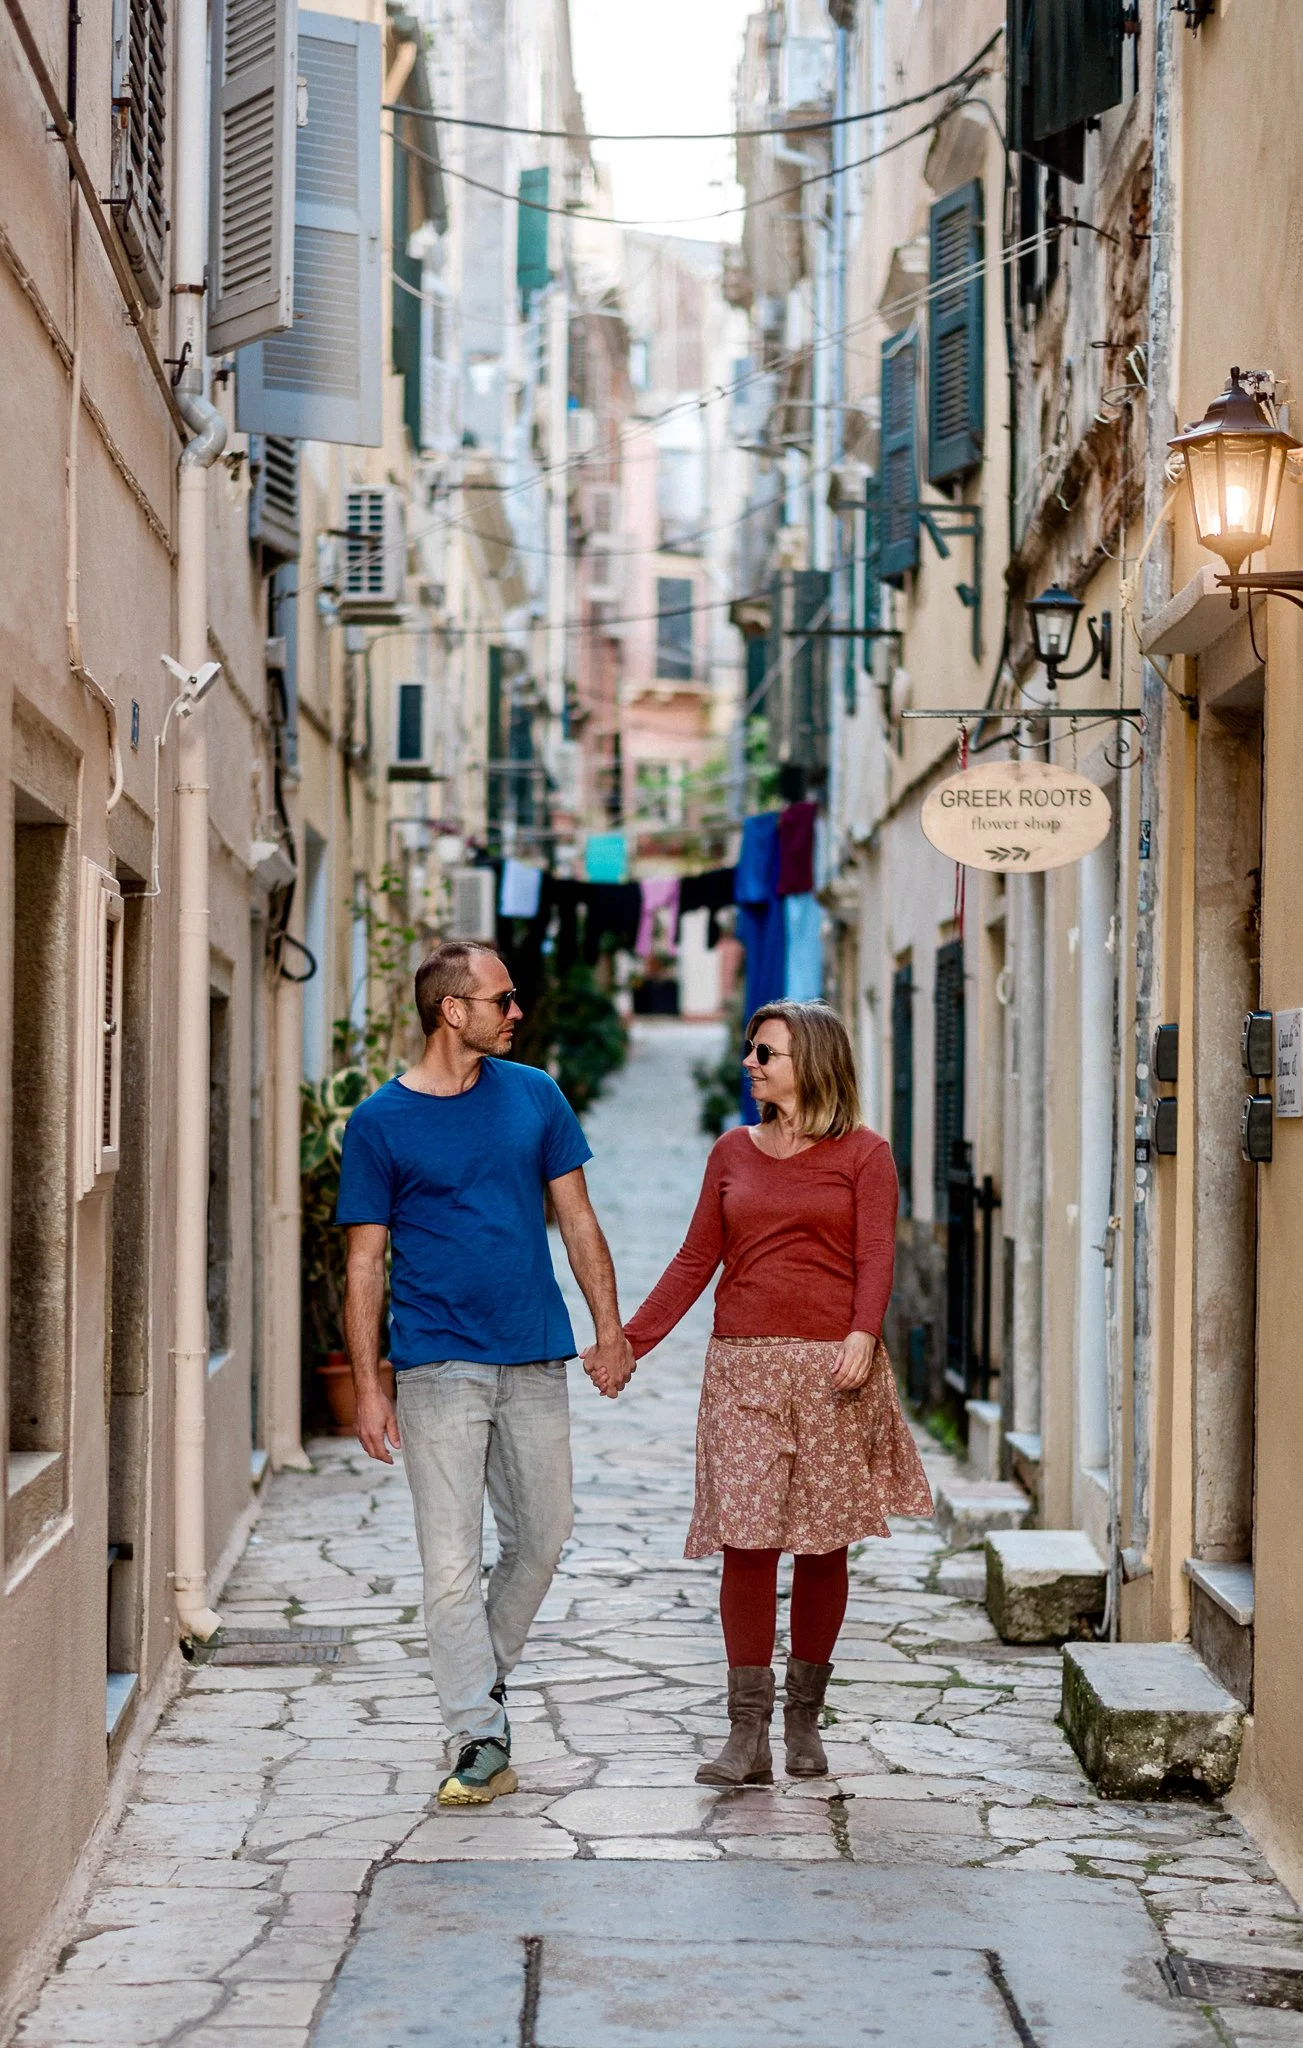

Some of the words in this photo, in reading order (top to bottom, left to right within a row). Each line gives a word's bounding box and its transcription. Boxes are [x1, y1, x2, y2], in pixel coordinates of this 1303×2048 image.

[940, 789, 1013, 808] GREEK
[1019, 788, 1092, 807] ROOTS
[971, 816, 1020, 830] flower
[1024, 816, 1061, 834] shop
